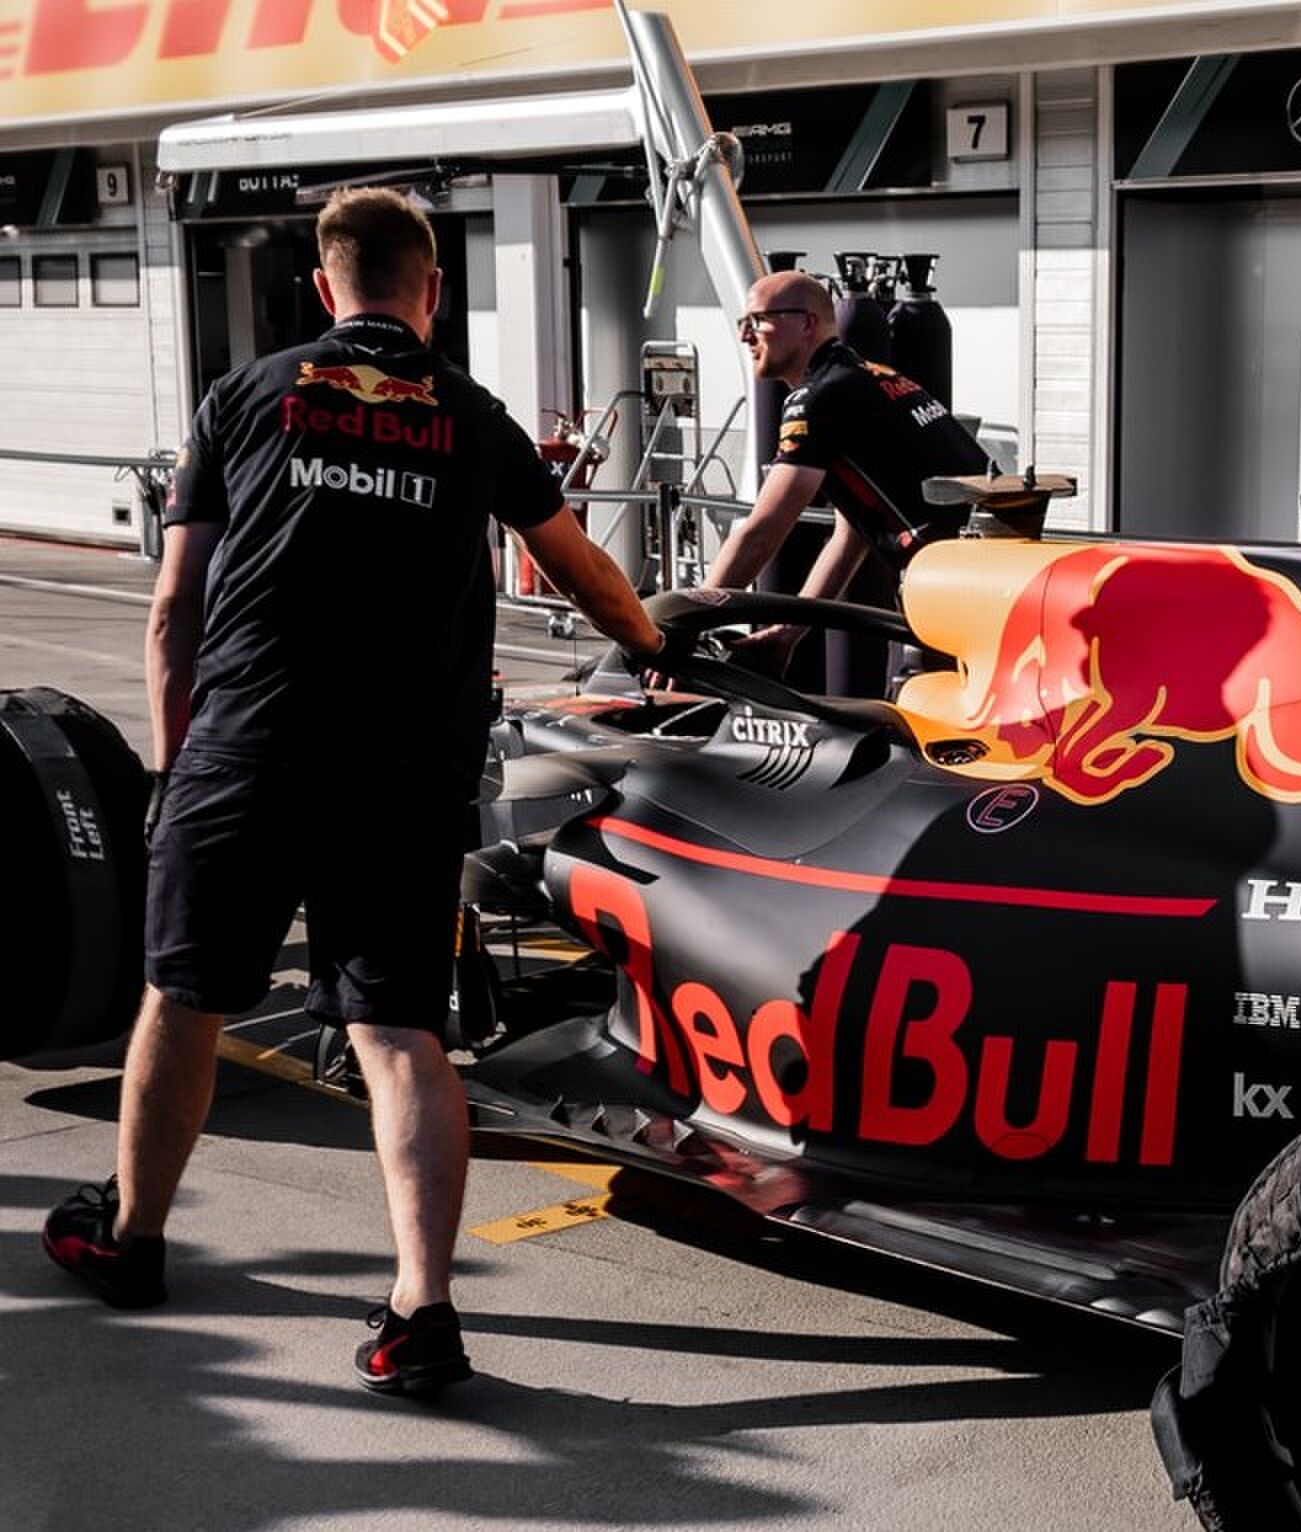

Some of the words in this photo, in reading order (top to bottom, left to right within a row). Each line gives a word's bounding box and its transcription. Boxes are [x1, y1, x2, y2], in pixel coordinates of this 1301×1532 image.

[967, 114, 987, 150] 7
[106, 173, 118, 198] 9
[280, 393, 365, 437] Red
[371, 410, 453, 455] Bull
[290, 457, 395, 499] Mobil
[56, 789, 88, 858] Front
[80, 806, 105, 860] Left
[568, 865, 863, 1134] Red
[857, 942, 1189, 1168] Bull
[1233, 991, 1301, 1029] IBM
[1232, 1071, 1295, 1119] kx
